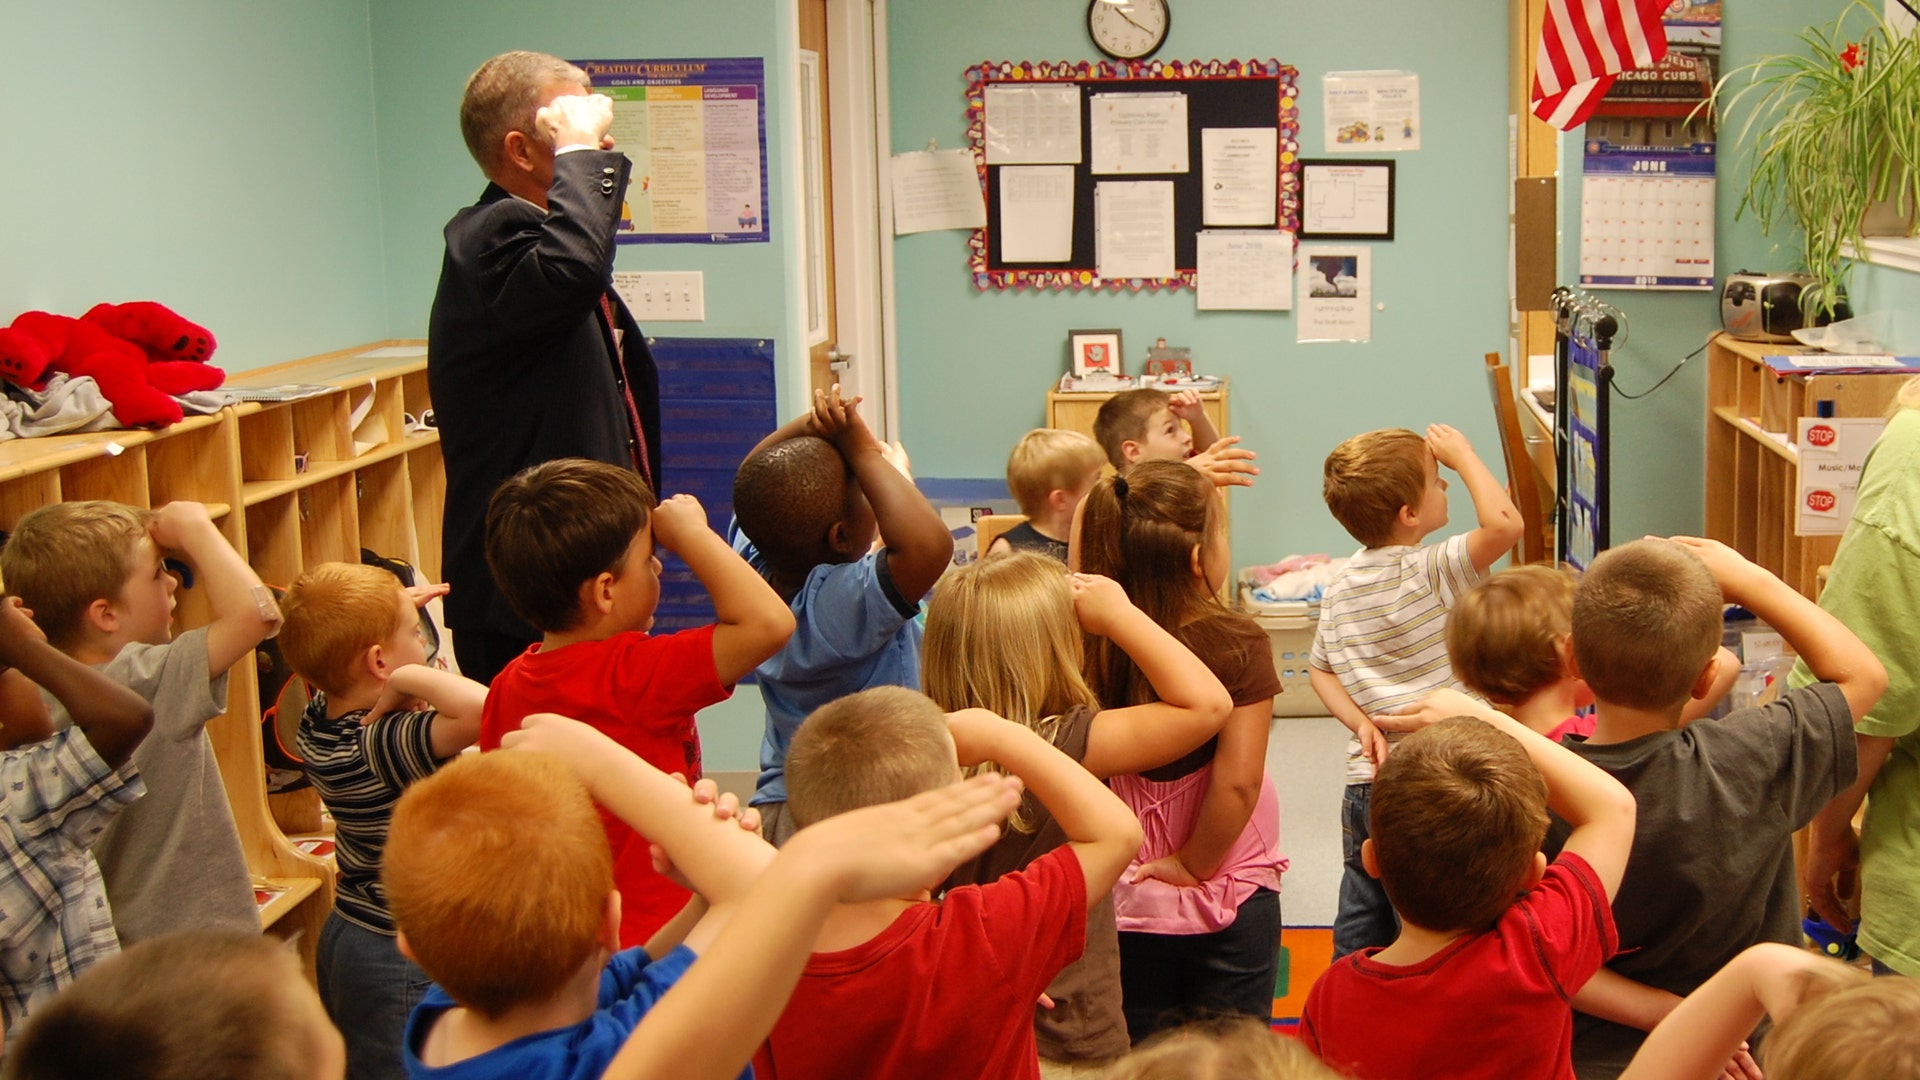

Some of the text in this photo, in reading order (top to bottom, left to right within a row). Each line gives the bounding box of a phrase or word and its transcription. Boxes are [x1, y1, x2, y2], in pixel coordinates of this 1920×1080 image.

[584, 63, 706, 76] CREATIVE CURRICULUM
[1617, 71, 1696, 80] ICAGO CUBS
[1632, 160, 1667, 171] JUNE
[1808, 430, 1834, 442] STOP
[1808, 495, 1834, 507] STOP
